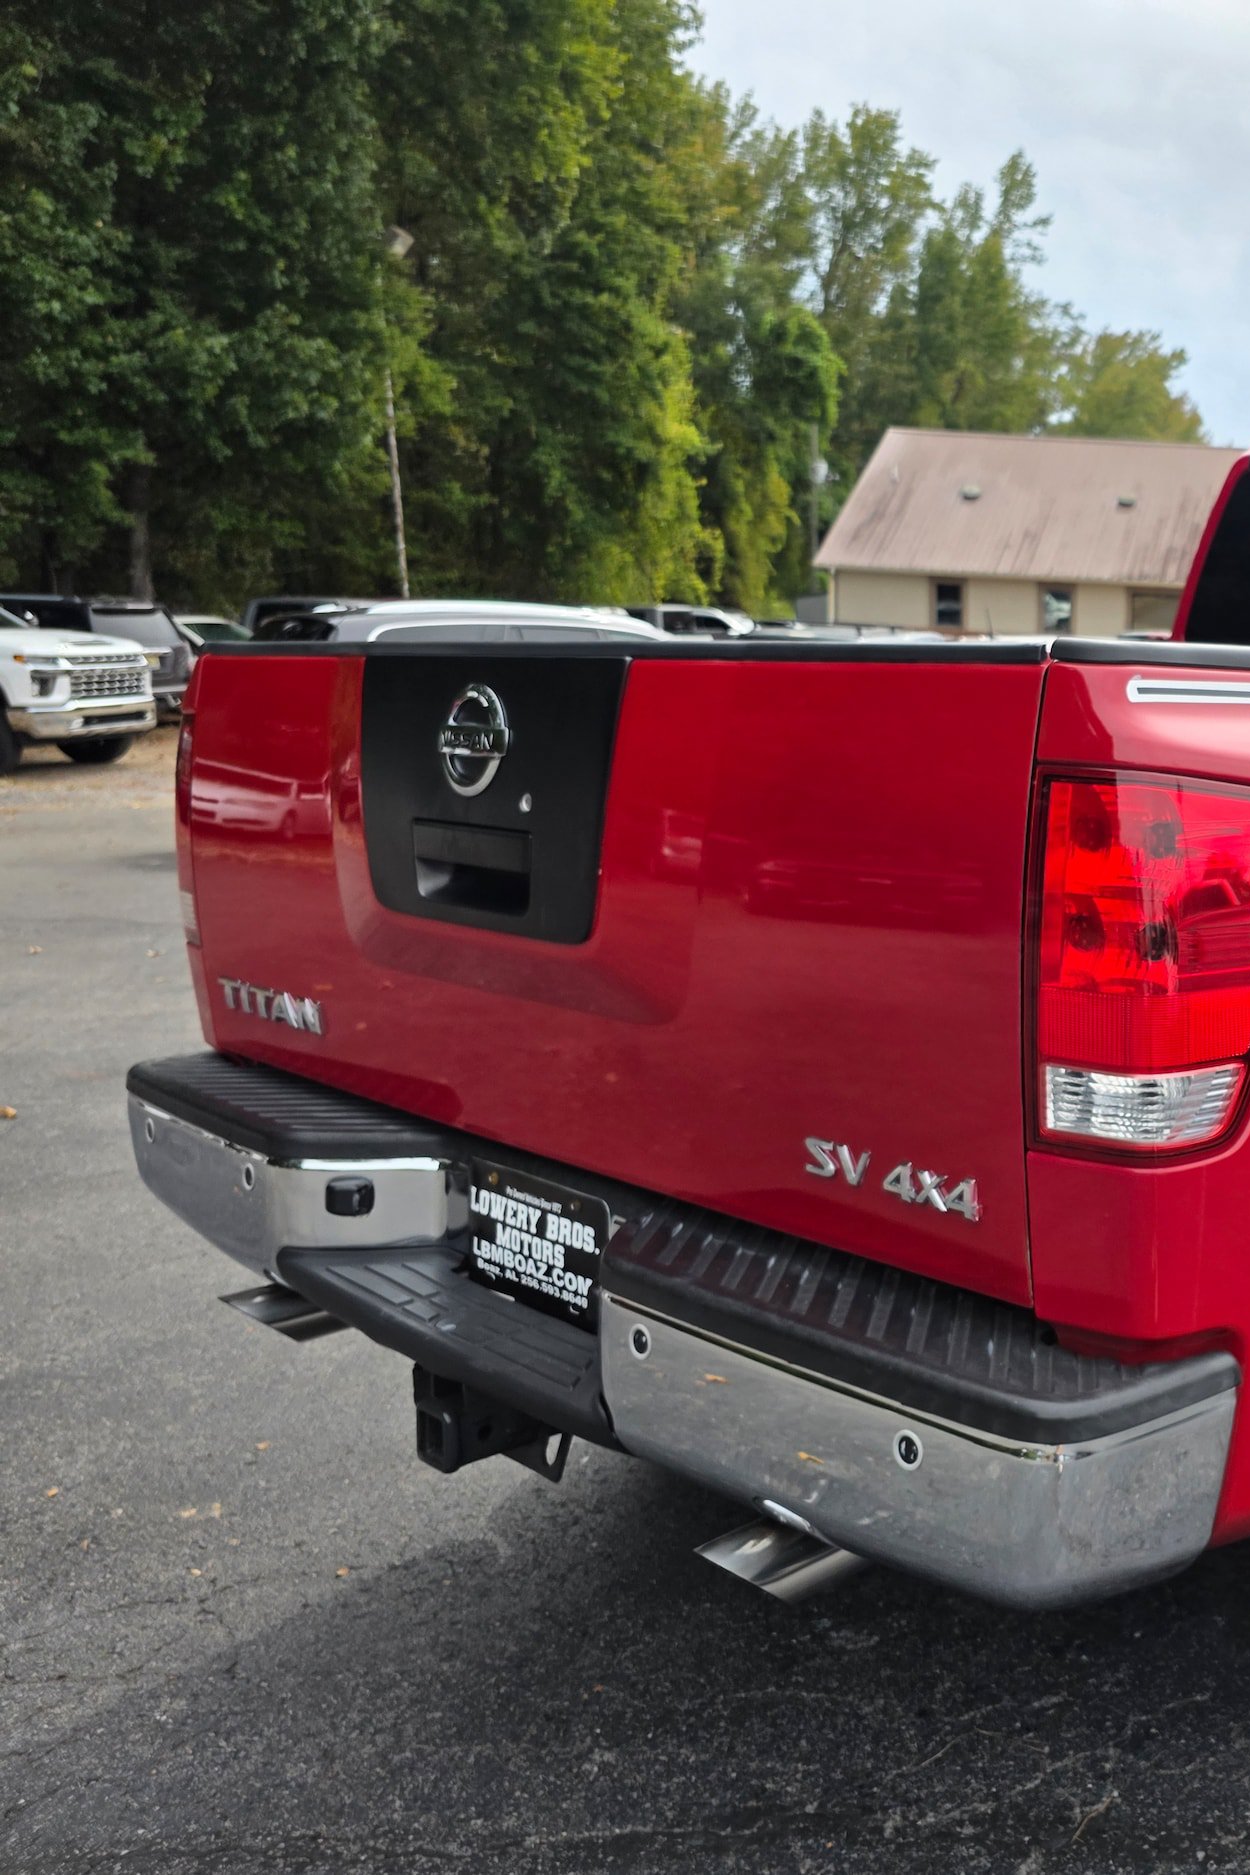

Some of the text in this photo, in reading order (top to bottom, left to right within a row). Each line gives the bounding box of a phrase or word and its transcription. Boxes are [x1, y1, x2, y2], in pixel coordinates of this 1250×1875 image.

[441, 730, 494, 750] NISSAN
[217, 976, 323, 1036] TITAN
[804, 1136, 872, 1187] SV
[470, 1185, 600, 1256] LOWERY BROS.
[495, 1222, 565, 1269] MOTORS
[505, 1268, 519, 1282] AL
